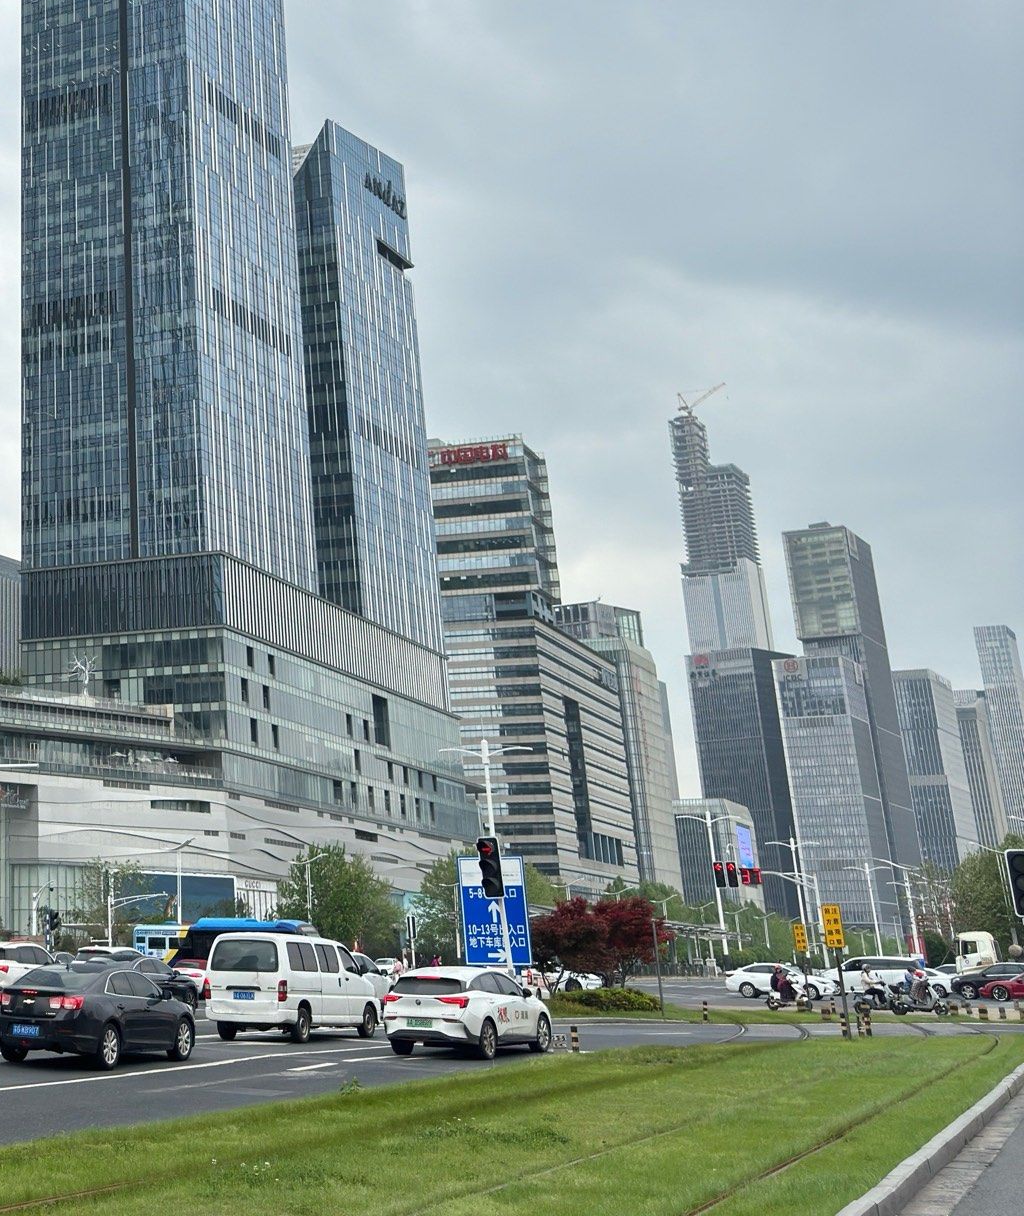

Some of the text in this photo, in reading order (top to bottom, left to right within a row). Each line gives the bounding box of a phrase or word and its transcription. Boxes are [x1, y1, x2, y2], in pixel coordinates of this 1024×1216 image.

[469, 937, 526, 948] 地下车库入口
